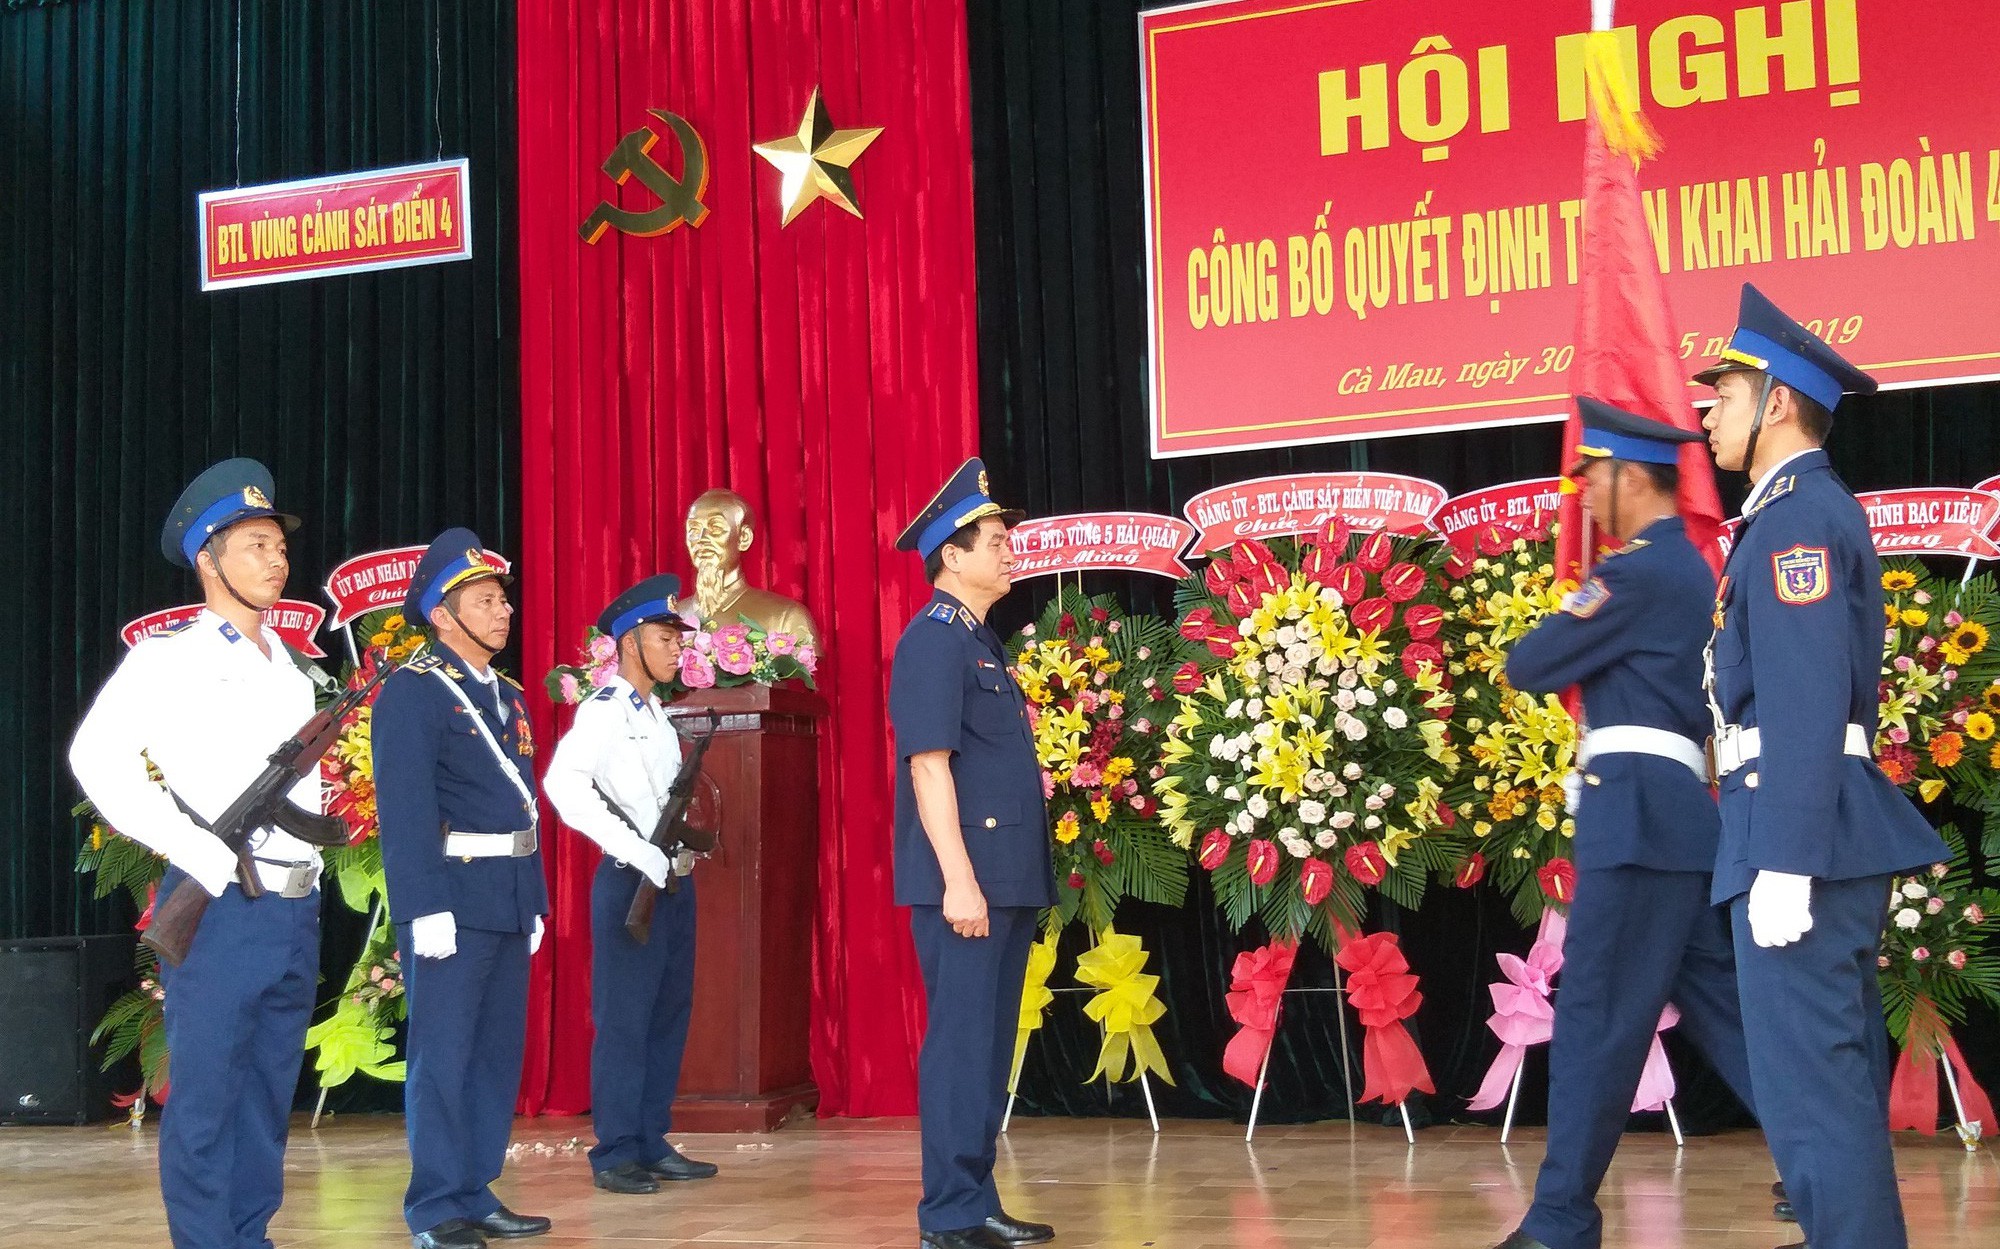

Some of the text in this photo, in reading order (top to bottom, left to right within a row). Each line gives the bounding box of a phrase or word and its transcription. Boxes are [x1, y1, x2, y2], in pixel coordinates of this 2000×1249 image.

[1318, 35, 1510, 162] HỘI
[217, 182, 453, 266] BTL VÙNG CẢNH SÁT BIỂN 4
[1188, 228, 1279, 330] CÔNG
[1288, 201, 1334, 318] BỐ
[1344, 190, 1452, 320] QUYẾT
[1461, 203, 1552, 314] ĐỊNH
[1680, 175, 1772, 271] KHAI
[1781, 137, 1851, 260] HẢI
[1861, 136, 1976, 252] ĐOÀN
[1337, 365, 1371, 395] Cà
[1377, 363, 1448, 392] Mau,
[1458, 352, 1530, 391] ngày
[1533, 344, 1575, 376] 30
[1679, 331, 1700, 360] 5
[1796, 315, 1864, 346] 019
[1196, 492, 1231, 529] ĐẢNG
[1232, 491, 1249, 522] ỦY
[1257, 492, 1281, 516] BTL
[1282, 482, 1315, 513] CẢNH
[1317, 483, 1340, 511] SÁT
[1341, 475, 1372, 509] BIỂN
[1374, 484, 1404, 516] VIỆT
[1403, 486, 1434, 517] NAM
[1443, 506, 1479, 534] ĐẢNG
[1480, 498, 1498, 523] ỦY
[1507, 496, 1532, 518] BTL
[1533, 488, 1562, 512] VÙN
[1866, 495, 1983, 530] TỈNH BẠC LIÊU
[1066, 521, 1101, 547] VÙNG
[1104, 527, 1113, 545] 5
[1115, 517, 1140, 545] HẢI
[1141, 521, 1181, 550] QUÂN
[336, 572, 352, 598] ỦY
[353, 567, 378, 592] BAN
[377, 558, 408, 585] NHÂN
[1067, 549, 1141, 566] Mừng
[280, 610, 305, 630] KHU
[303, 613, 314, 632] 9
